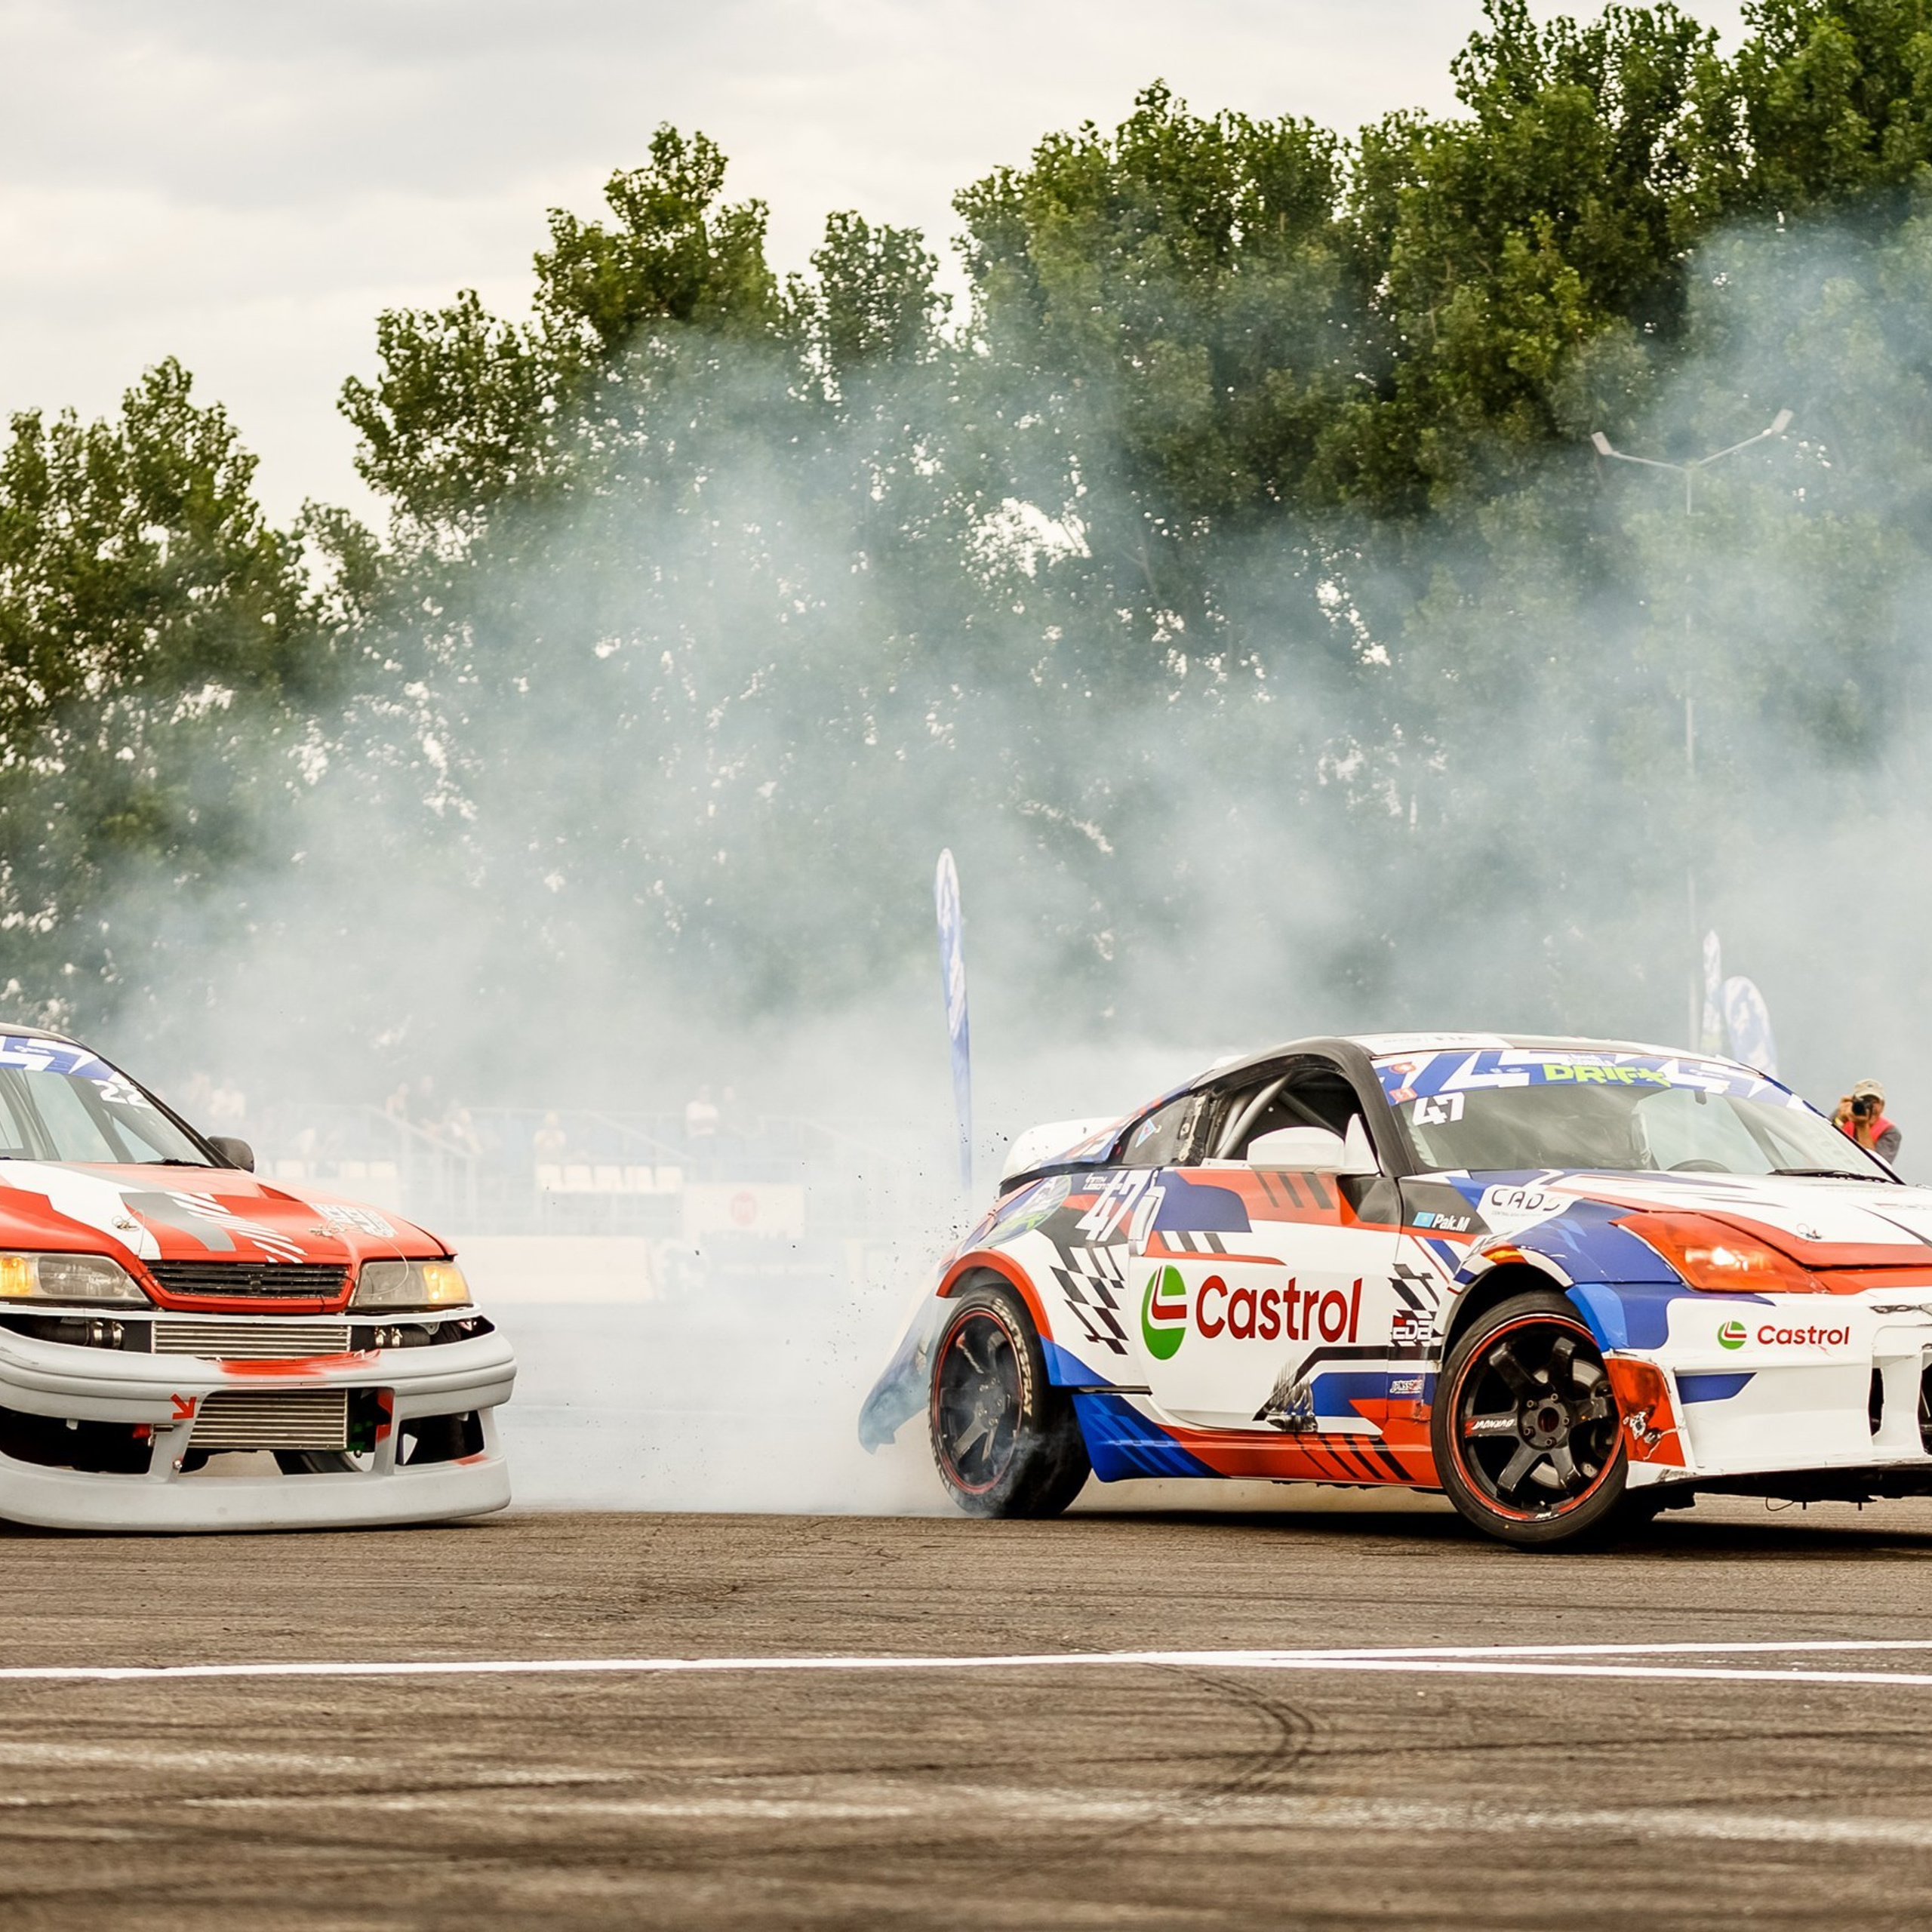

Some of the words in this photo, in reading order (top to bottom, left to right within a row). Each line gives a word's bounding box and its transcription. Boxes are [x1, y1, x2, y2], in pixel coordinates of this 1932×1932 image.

[1543, 1063, 1672, 1088] DRIFT
[91, 1079, 153, 1110] 22
[1413, 1091, 1465, 1126] 47
[1196, 1275, 1363, 1343] Castrol
[1757, 1324, 1850, 1345] Castrol
